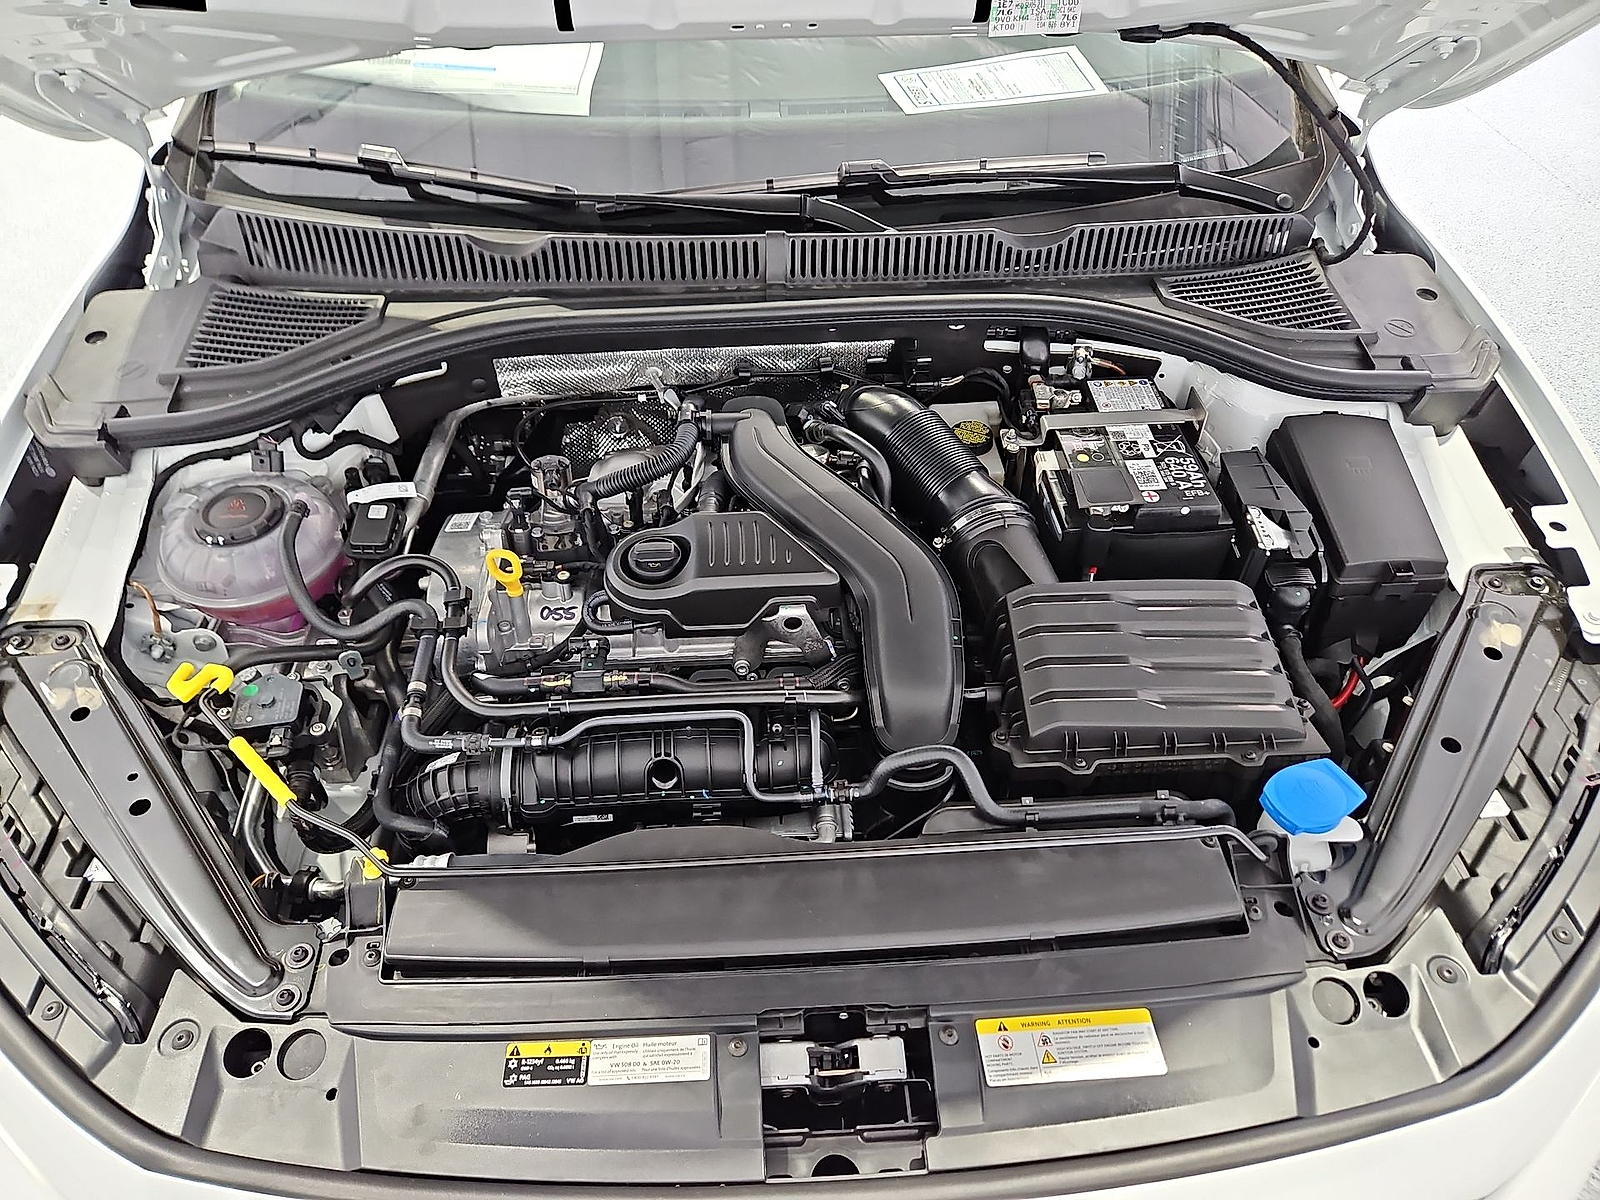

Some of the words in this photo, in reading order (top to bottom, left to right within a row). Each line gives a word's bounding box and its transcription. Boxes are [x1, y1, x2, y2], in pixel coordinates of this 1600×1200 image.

[1164, 456, 1184, 478] 640
[1177, 480, 1190, 491] A
[1181, 457, 1207, 489] 59Ah
